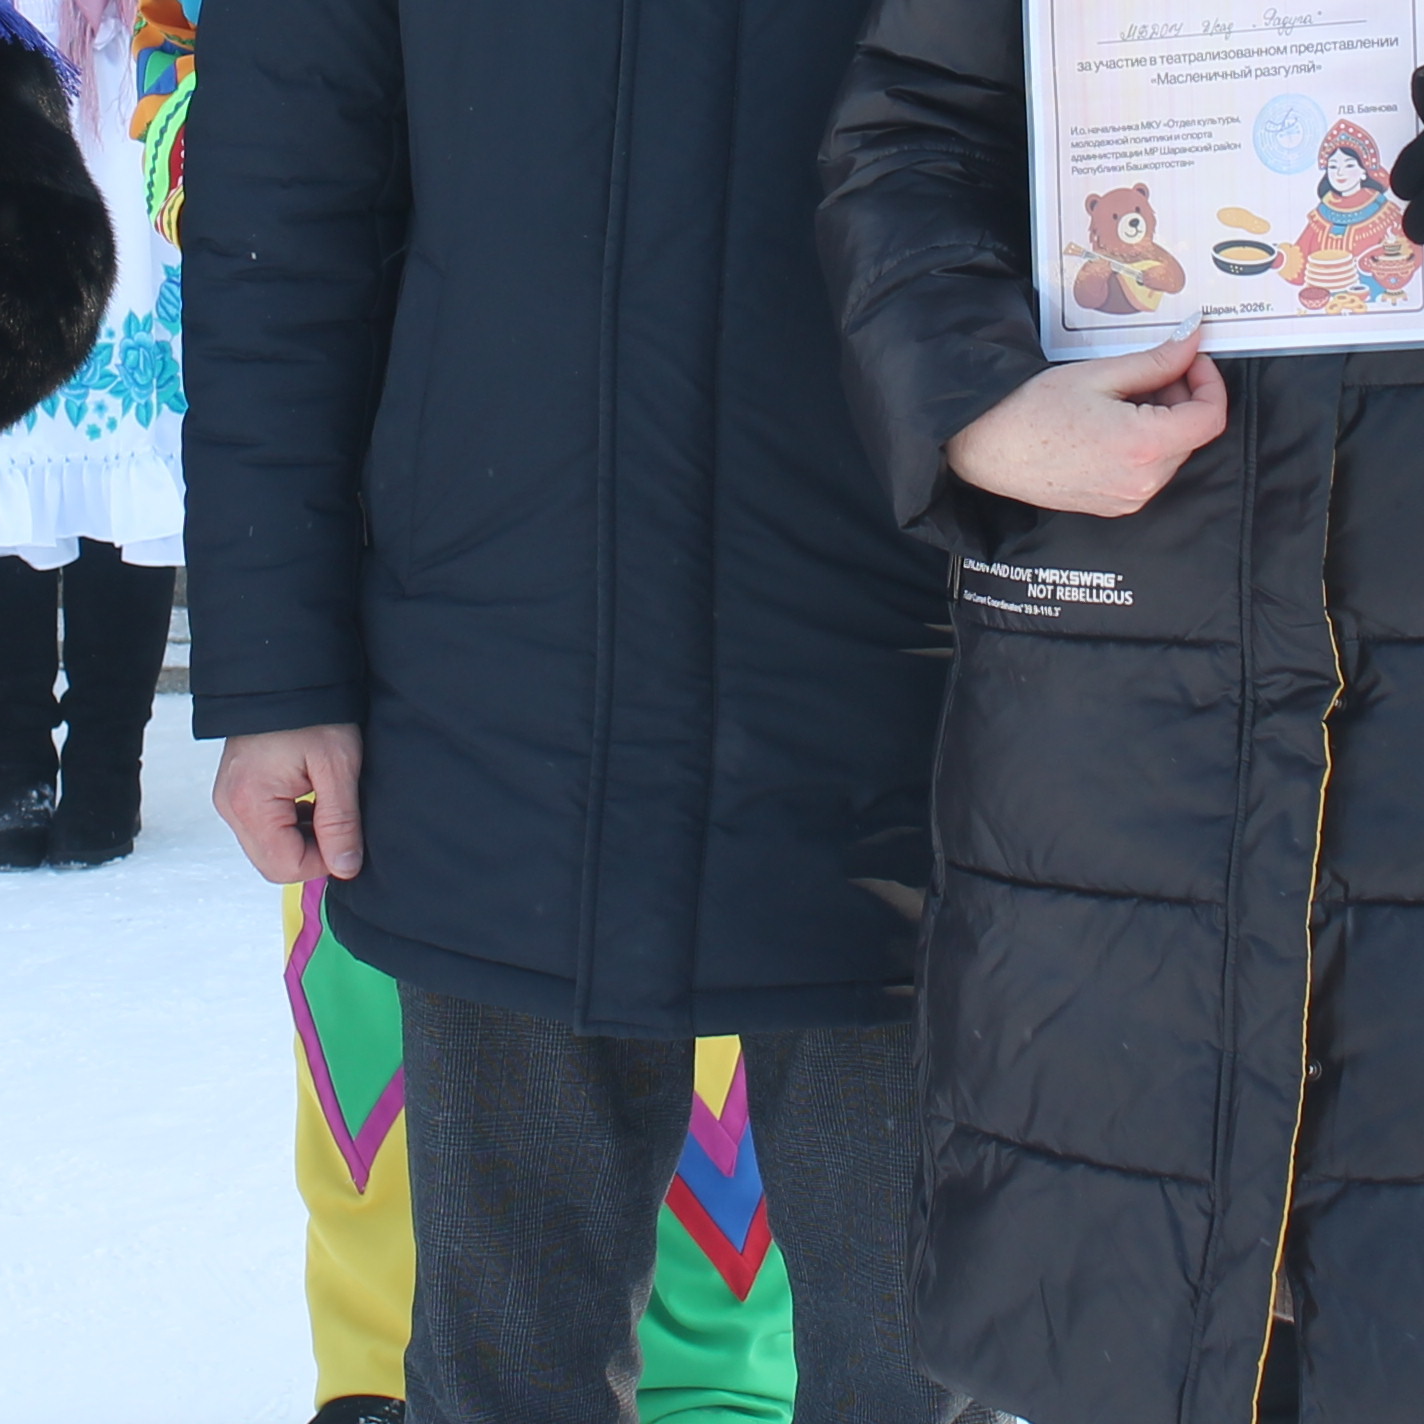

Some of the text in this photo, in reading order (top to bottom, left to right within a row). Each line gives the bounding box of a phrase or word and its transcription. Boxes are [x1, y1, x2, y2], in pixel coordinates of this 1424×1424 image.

[1077, 36, 1399, 73] за участие в театрализованном представлении
[1151, 61, 1322, 85] «Масленичный разгуляй»
[1357, 103, 1398, 114] Баянова
[1088, 122, 1139, 135] начальника
[1140, 119, 1162, 131] МКУ
[1071, 136, 1128, 149] молодежной
[1130, 133, 1173, 145] политики
[1181, 131, 1213, 143] спорта
[1071, 141, 1241, 163] администрации МР Шаранский район
[1071, 162, 1124, 176] Республики
[1201, 304, 1238, 316] Шаран,
[990, 562, 1009, 578] AND
[1010, 566, 1033, 582] LOVE
[1028, 583, 1134, 606] NOT REBELLIOUS
